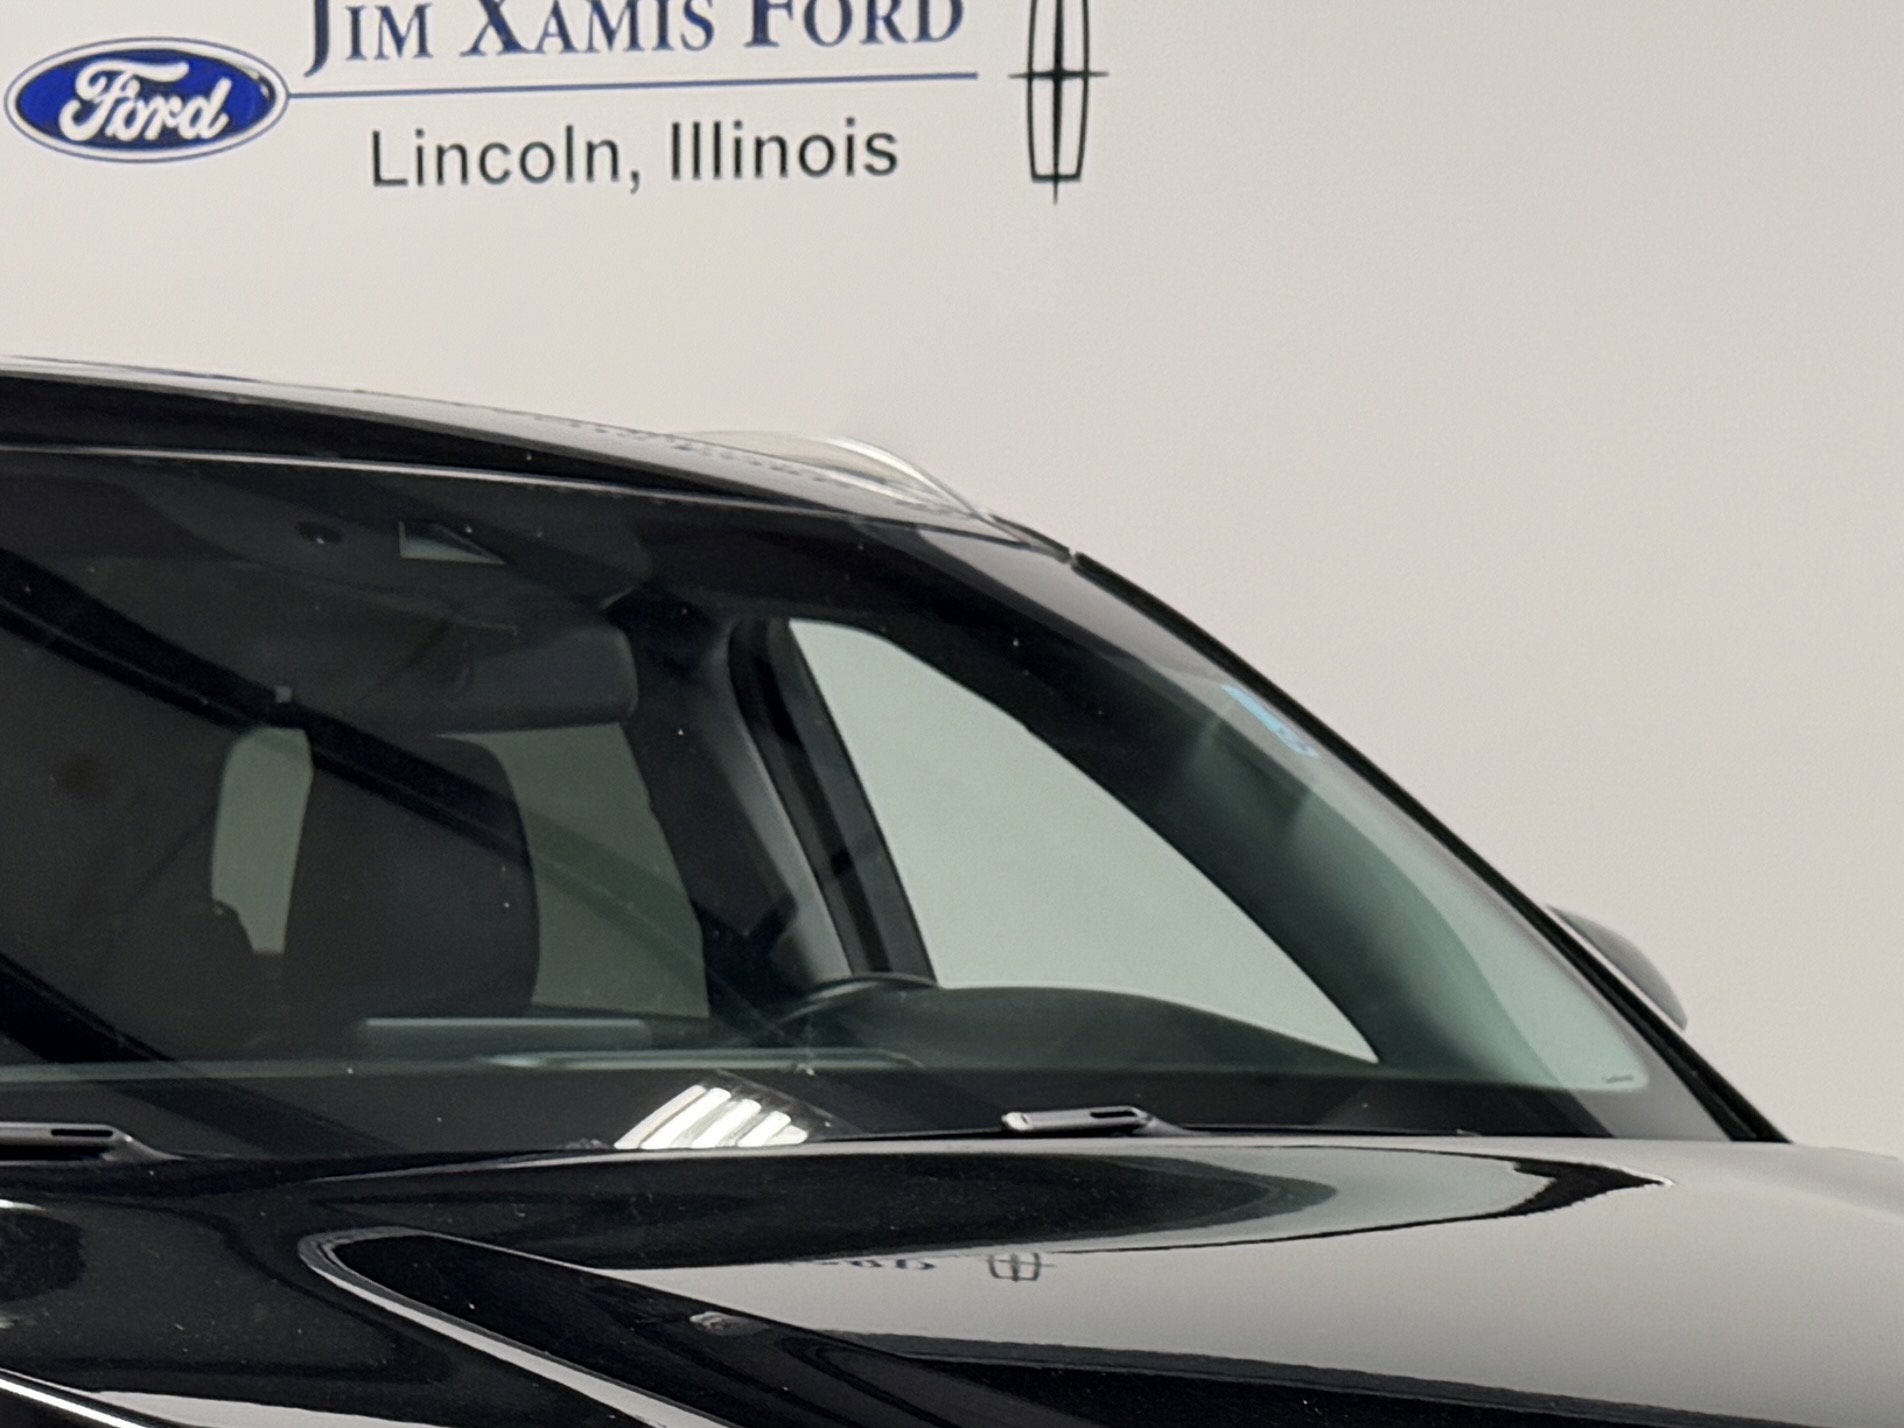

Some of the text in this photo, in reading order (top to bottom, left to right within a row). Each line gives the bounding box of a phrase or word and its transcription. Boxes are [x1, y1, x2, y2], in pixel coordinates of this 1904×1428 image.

[303, 0, 965, 77] JIM XAMIS FORD
[57, 57, 233, 142] Ford
[371, 116, 898, 195] Lincoln, Illinois
